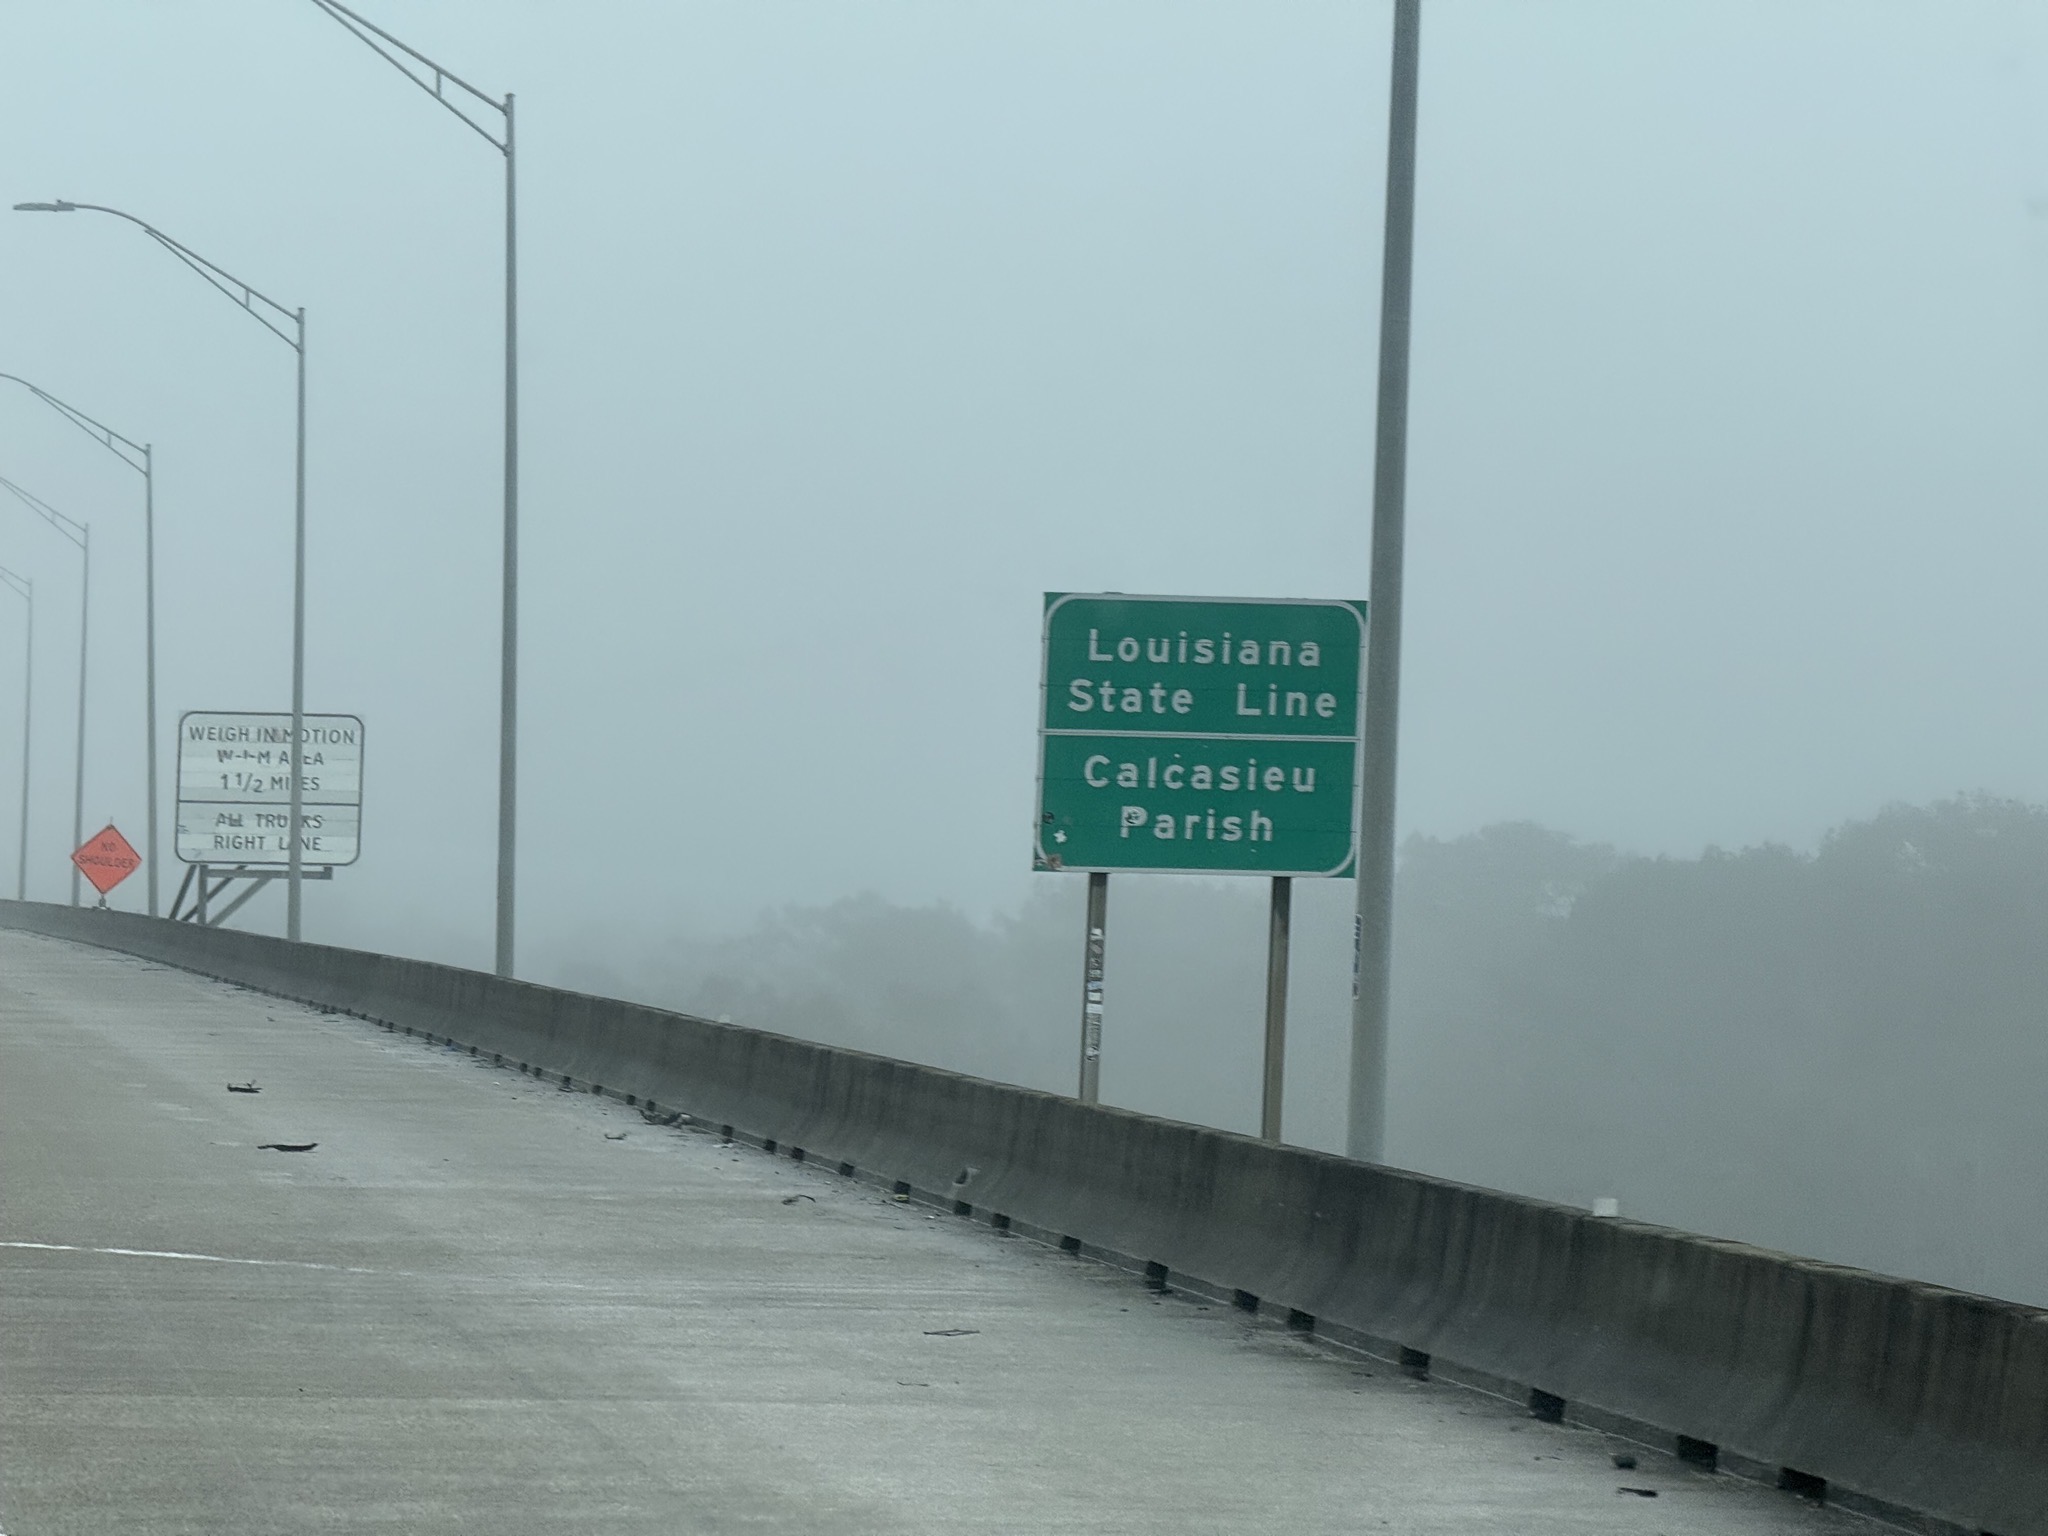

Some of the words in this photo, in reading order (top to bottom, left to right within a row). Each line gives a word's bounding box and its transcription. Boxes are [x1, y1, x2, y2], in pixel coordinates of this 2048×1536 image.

[1088, 628, 1321, 667] Louisiana
[1067, 678, 1194, 714] State
[1236, 682, 1338, 717] Line
[189, 726, 250, 742] WEIGH
[257, 729, 275, 743] IN
[278, 751, 325, 766] AEA
[1083, 754, 1315, 793] Calcasieu
[270, 776, 321, 791] MIES
[214, 812, 244, 827] ALL
[255, 813, 324, 829] TRUKS
[1120, 805, 1274, 842] Parish
[213, 835, 266, 850] RIGHT
[278, 836, 322, 851] LNE
